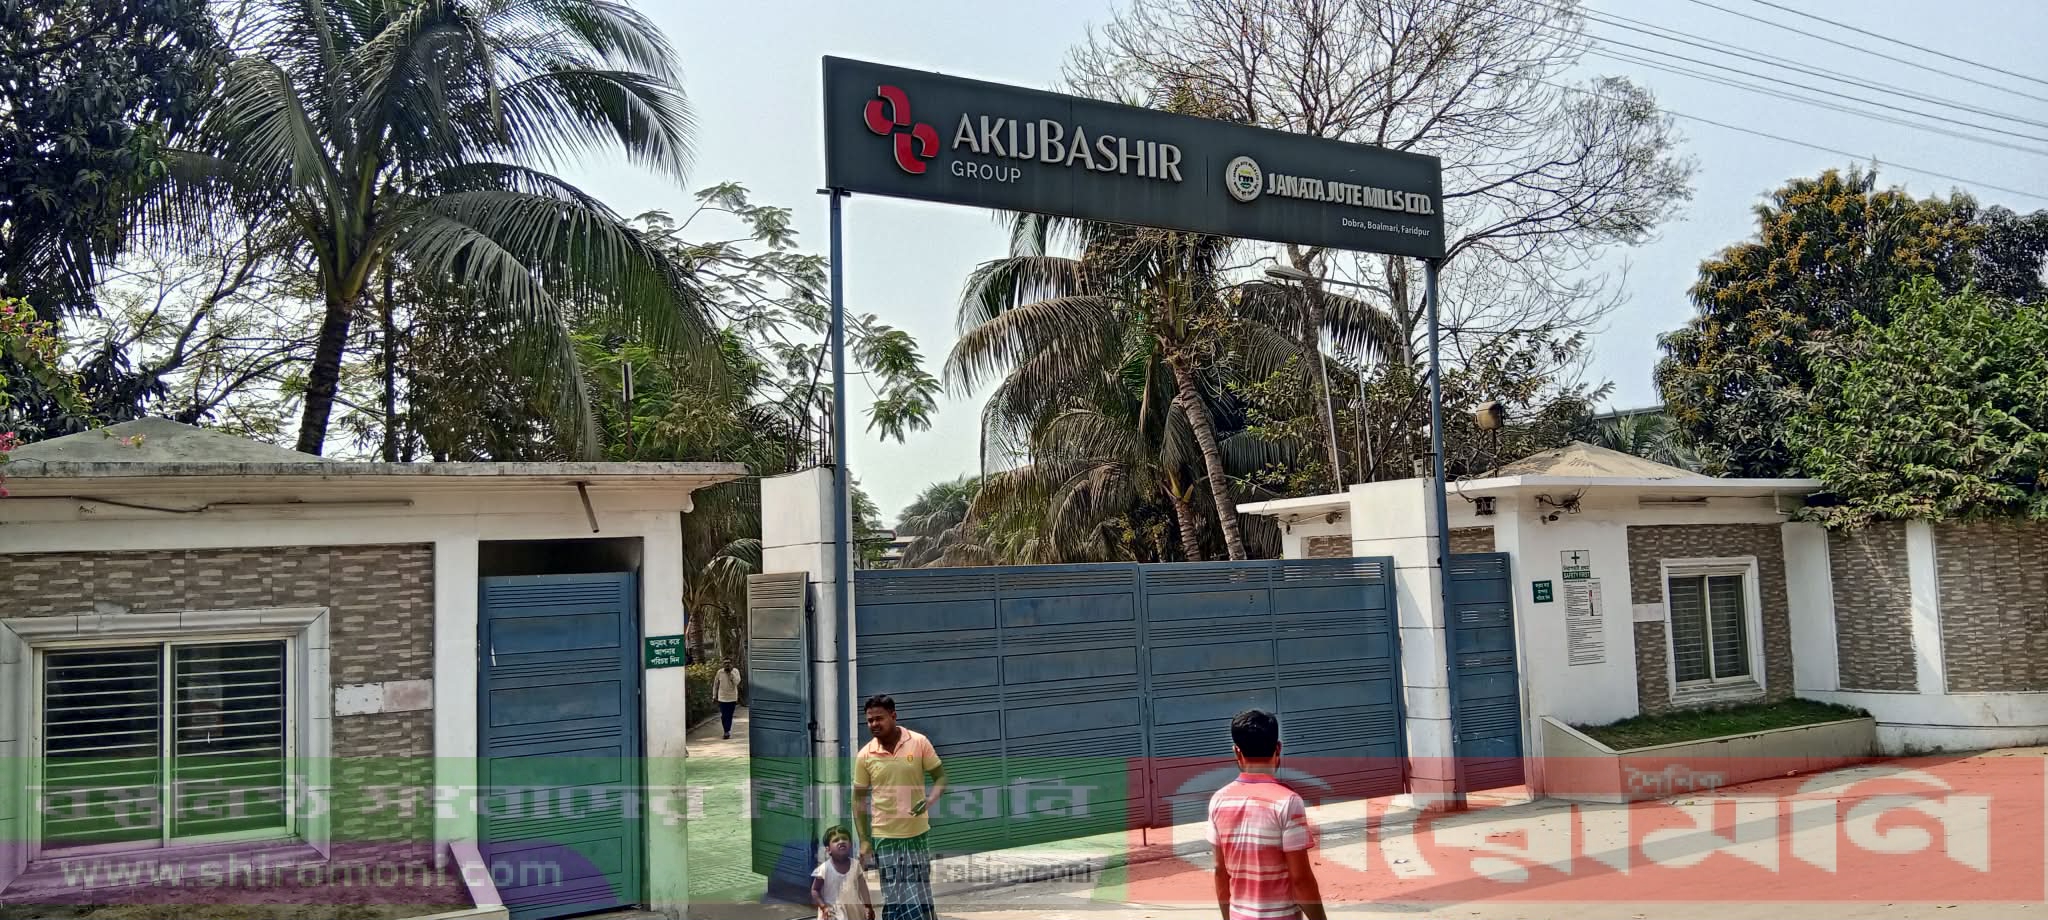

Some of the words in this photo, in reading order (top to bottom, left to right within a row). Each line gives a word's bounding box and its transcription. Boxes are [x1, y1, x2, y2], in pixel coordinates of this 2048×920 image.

[952, 113, 1183, 182] AKIJBASHIR
[951, 160, 1021, 183] GROUP
[1267, 173, 1325, 201] JANATA
[1325, 181, 1362, 206] JUTE
[1363, 186, 1404, 211] MILLS
[1405, 192, 1435, 215] LTD.
[1342, 217, 1367, 230] Dobra,
[1367, 220, 1400, 234] Boalmari,
[1401, 225, 1430, 237] Faridpur
